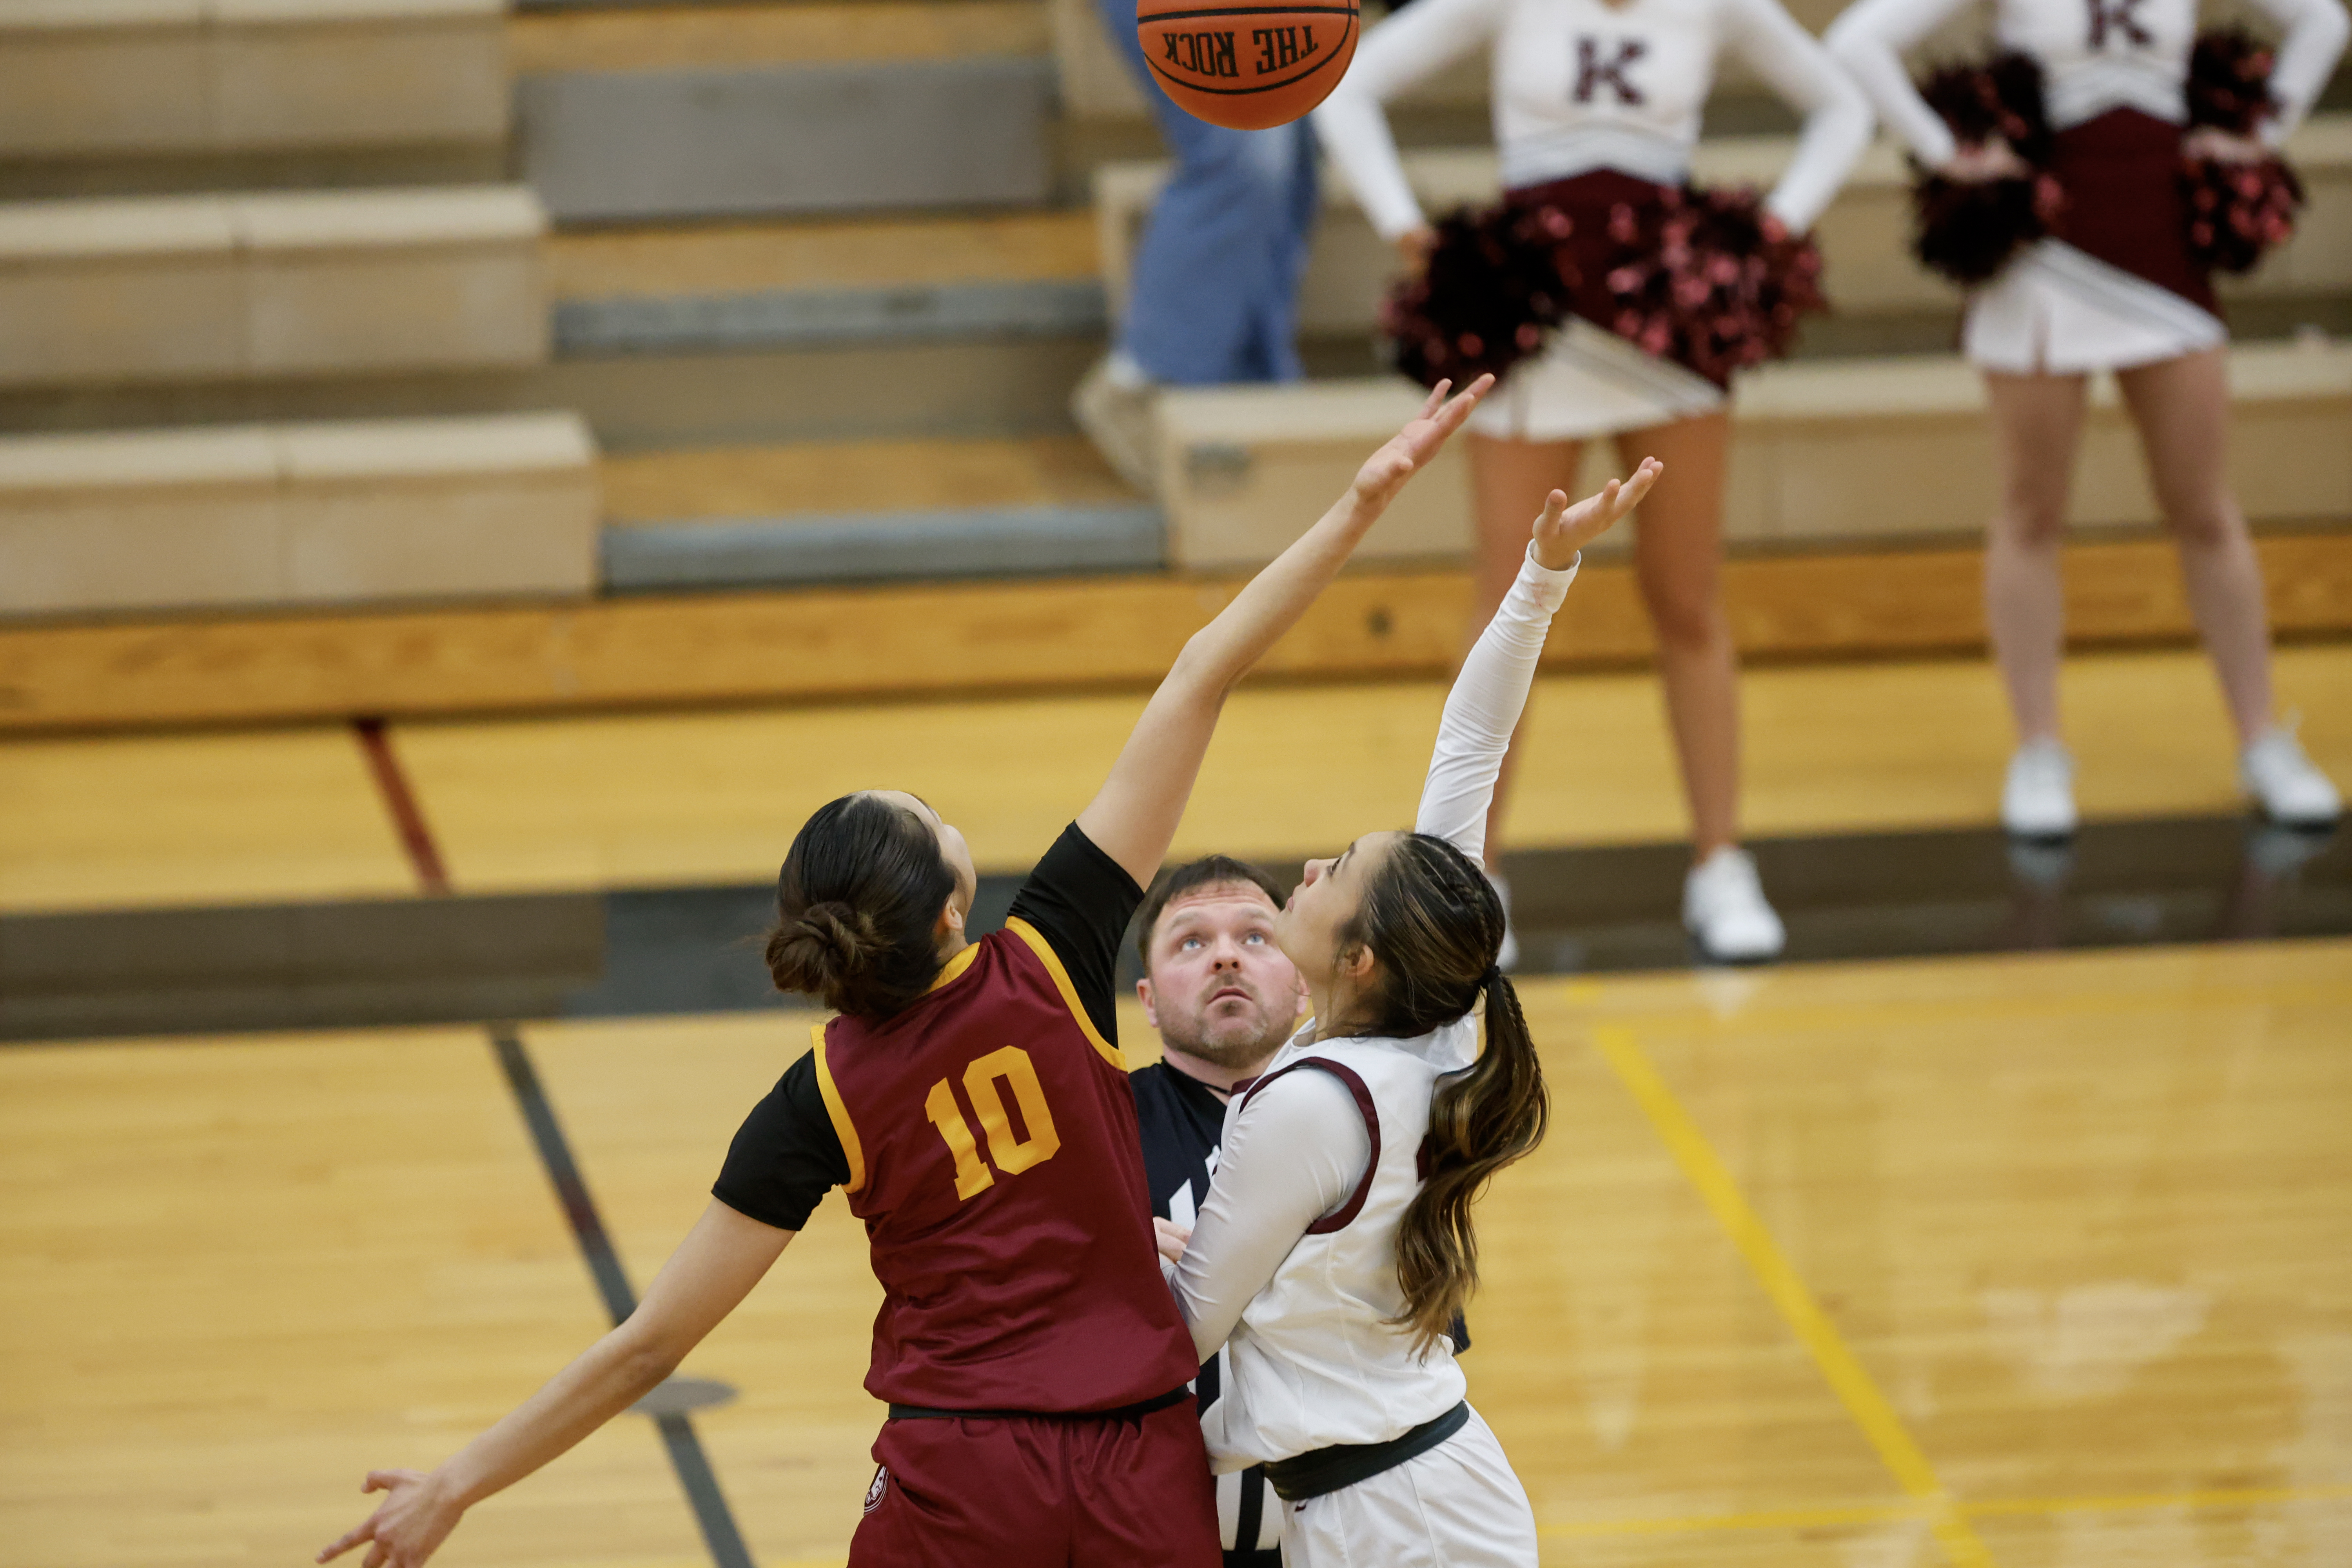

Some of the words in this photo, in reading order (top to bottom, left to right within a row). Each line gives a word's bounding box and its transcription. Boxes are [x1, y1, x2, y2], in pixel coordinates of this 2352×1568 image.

[2087, 0, 2154, 49] K
[1162, 32, 1240, 77] ROCK
[1253, 26, 1319, 75] THE
[1572, 35, 1648, 103] K
[924, 1045, 1061, 1201] 10
